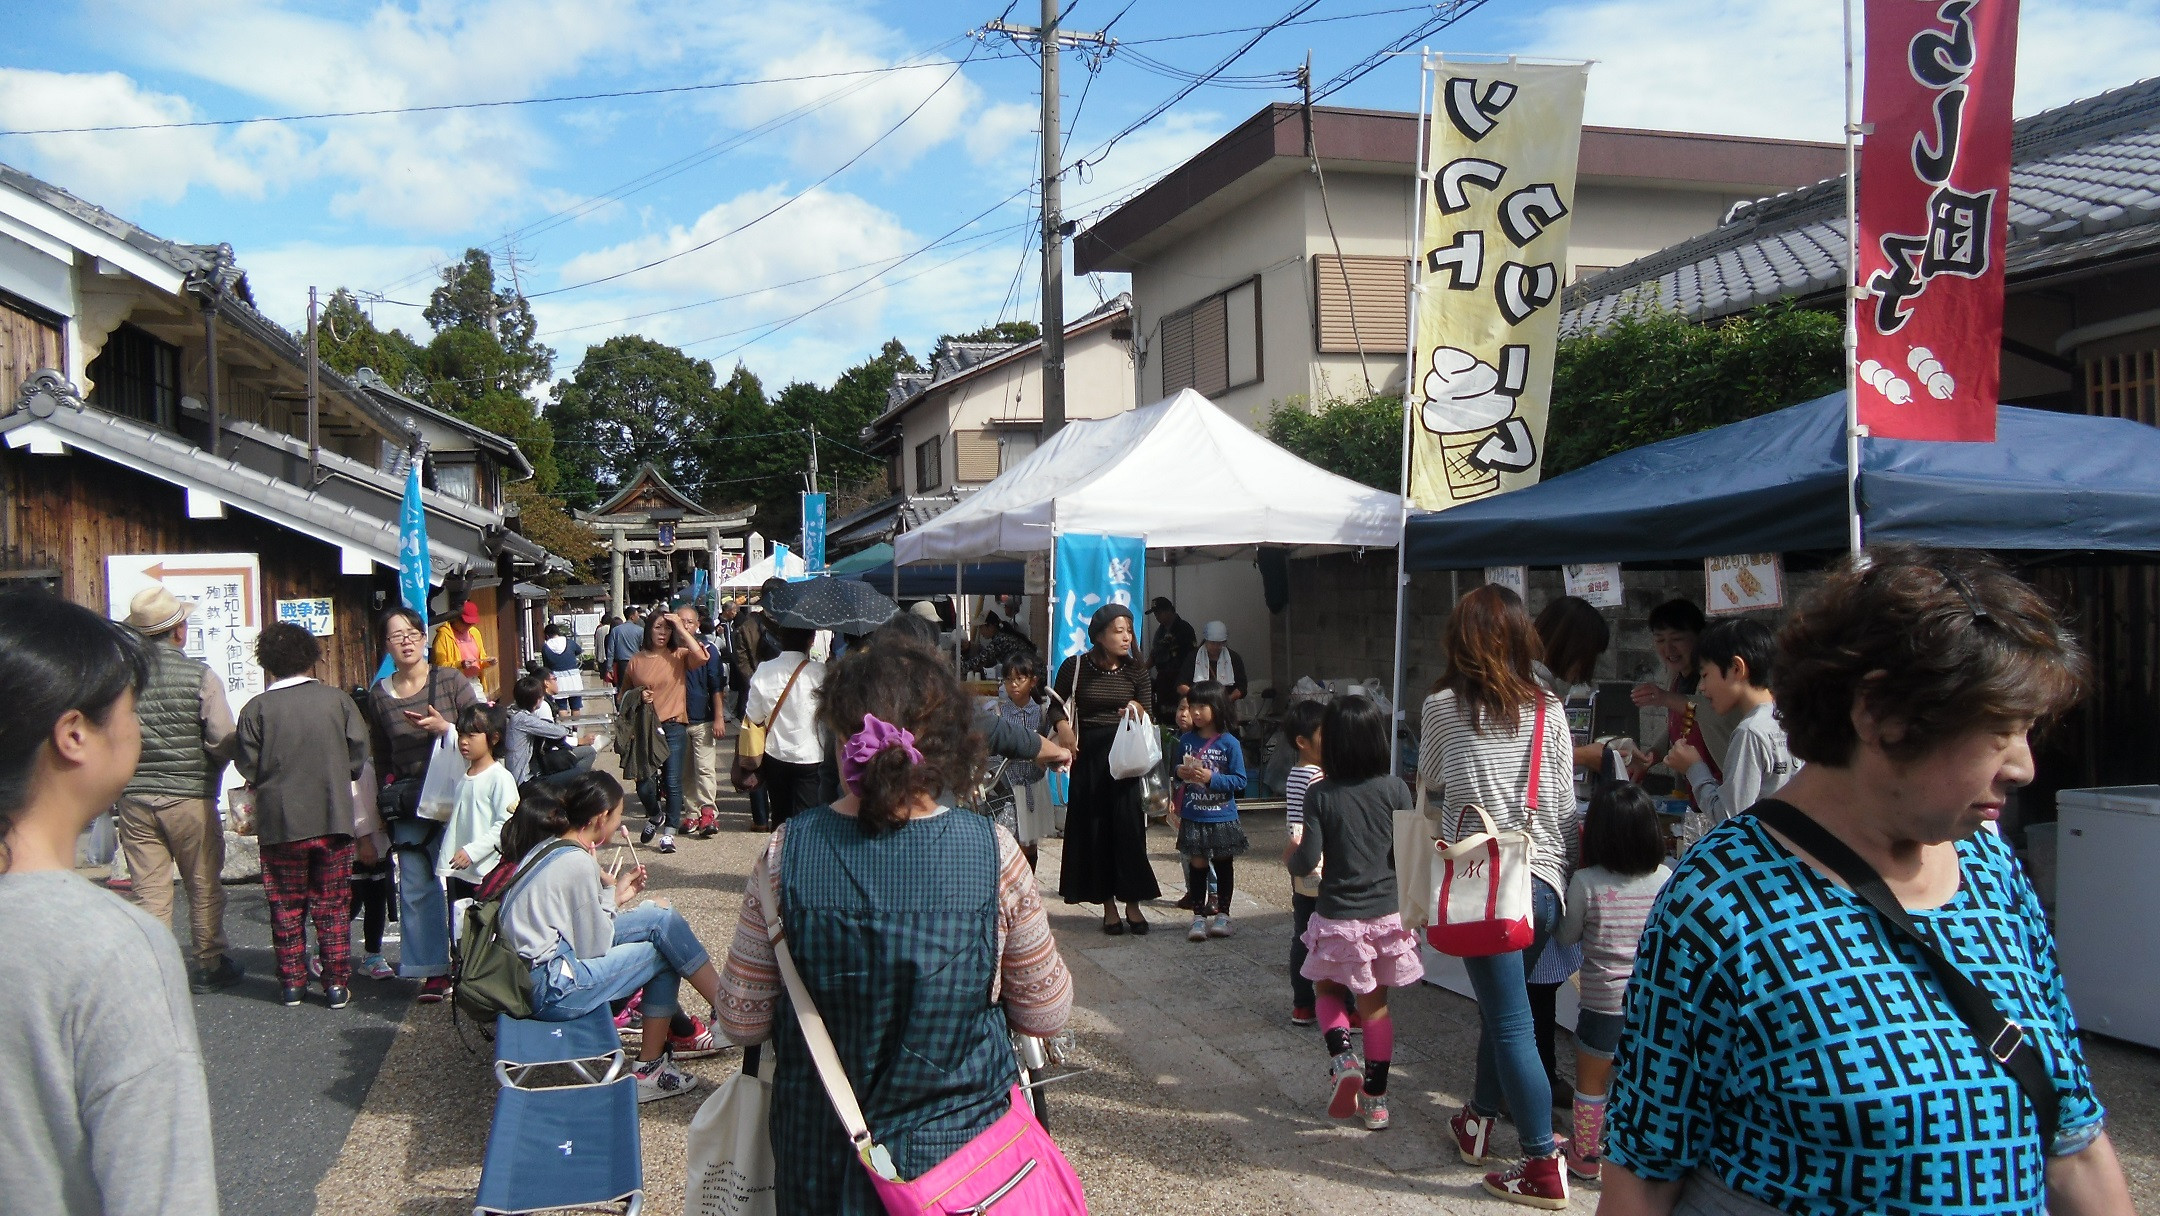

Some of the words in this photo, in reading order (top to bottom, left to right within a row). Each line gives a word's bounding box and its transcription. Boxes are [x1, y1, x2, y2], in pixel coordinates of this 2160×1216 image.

[281, 601, 330, 618] 戦争法
[223, 583, 245, 693] 蓮如上人御旧跡
[1190, 792, 1227, 801] SNAPPY
[1457, 860, 1484, 879] M
